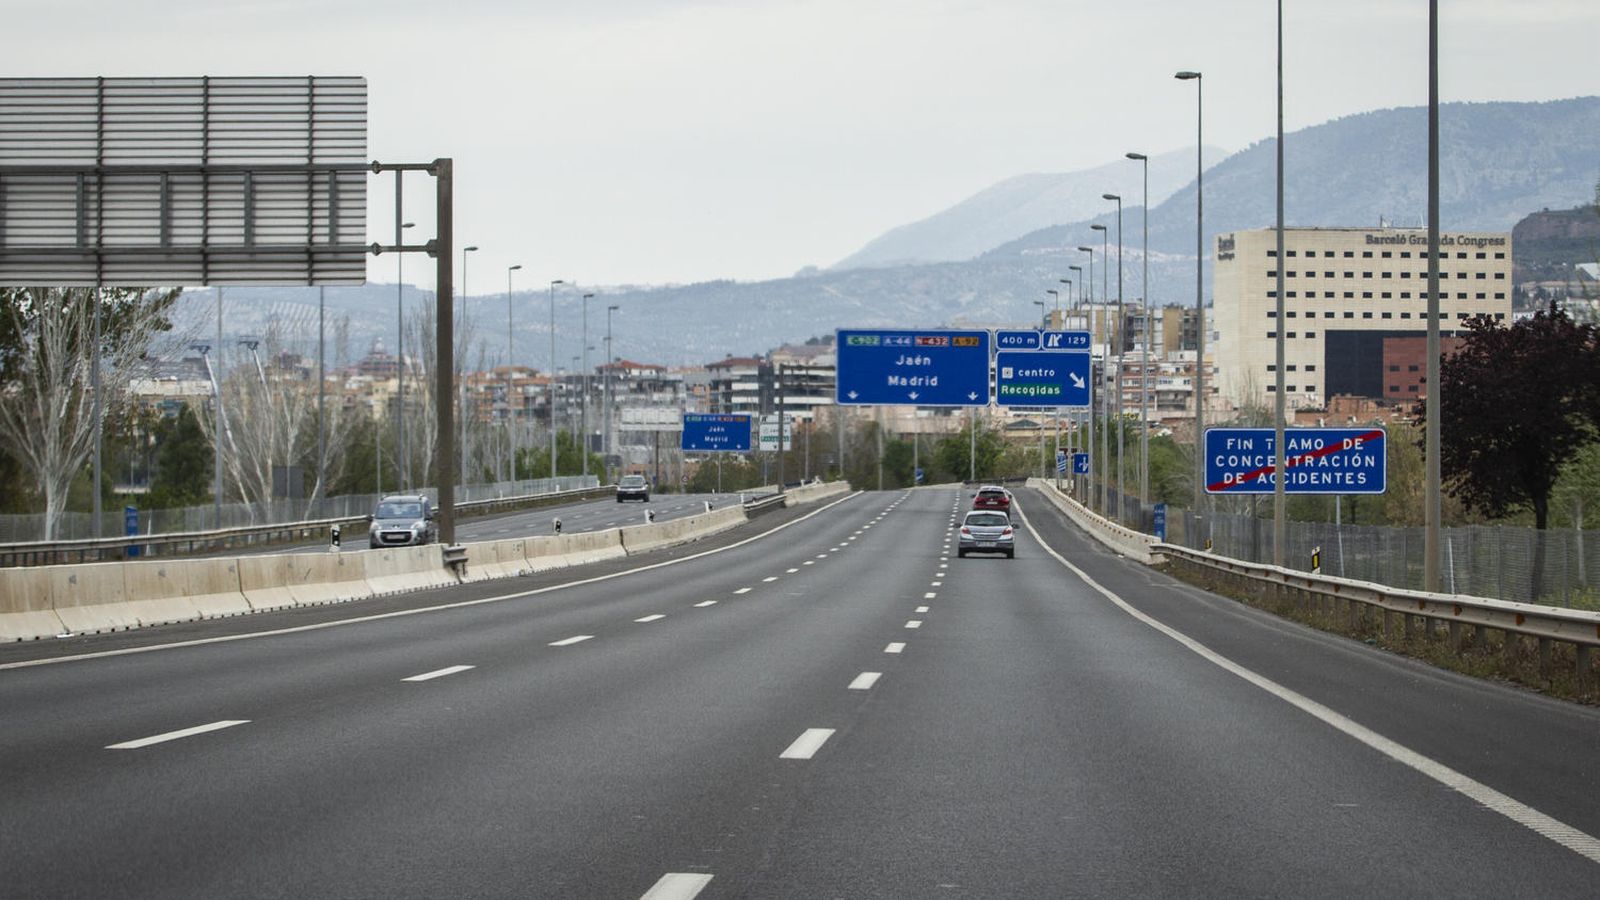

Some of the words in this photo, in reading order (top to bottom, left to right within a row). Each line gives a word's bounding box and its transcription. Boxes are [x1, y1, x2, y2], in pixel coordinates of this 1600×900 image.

[1366, 234, 1406, 245] Barceló
[1409, 235, 1454, 245] Grada
[1457, 236, 1505, 248] Congress
[896, 355, 931, 366] Jaén
[1018, 369, 1055, 377] centro
[888, 376, 938, 386] Madrid
[1002, 386, 1060, 396] Recogidas
[1227, 439, 1253, 449] FIN
[1265, 439, 1324, 450] TAMO
[1343, 439, 1363, 449] DE
[1224, 473, 1244, 484] DE
